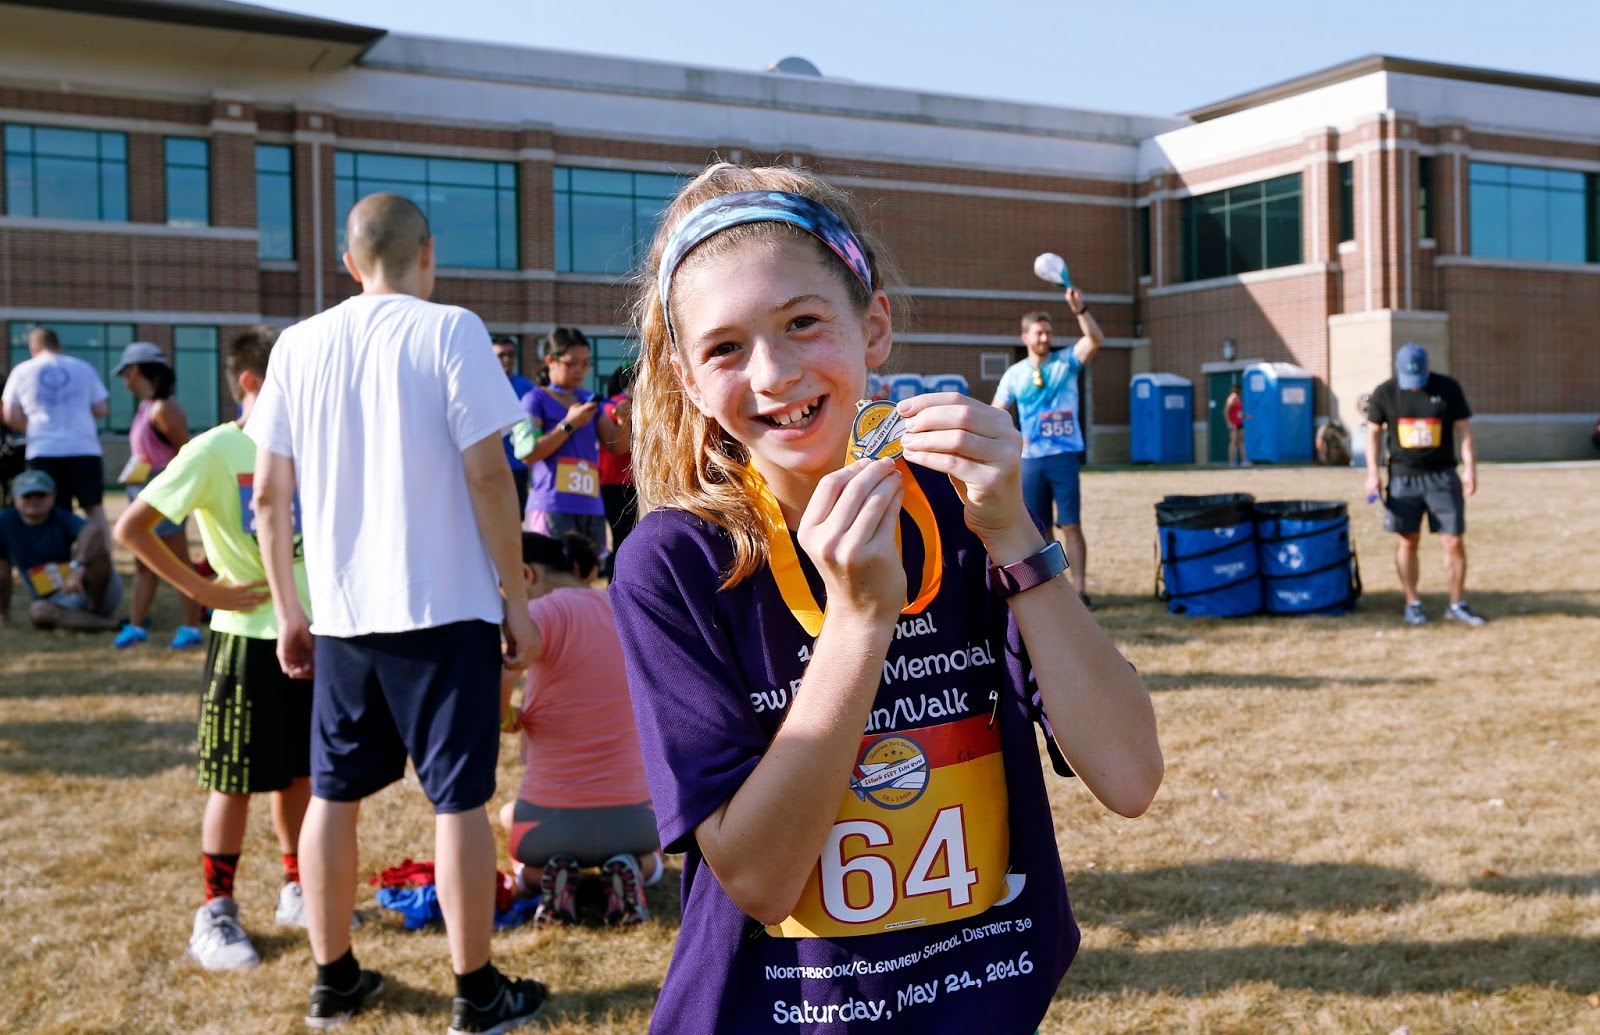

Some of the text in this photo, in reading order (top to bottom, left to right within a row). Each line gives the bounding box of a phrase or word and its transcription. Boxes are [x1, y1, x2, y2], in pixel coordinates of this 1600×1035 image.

[568, 471, 594, 495] 30
[891, 612, 938, 641] nual
[864, 688, 969, 732] un/Walk
[900, 742, 917, 754] District
[884, 770, 897, 779] FEET
[898, 764, 910, 774] FUN
[911, 758, 923, 768] RUN
[882, 794, 891, 802] 5K
[818, 803, 979, 924] 64
[923, 934, 962, 959] SCHOOL
[961, 920, 1012, 943] DISTRICT
[1015, 917, 1032, 932] 30
[772, 951, 1034, 1025] Saturday, May 21, 2016
